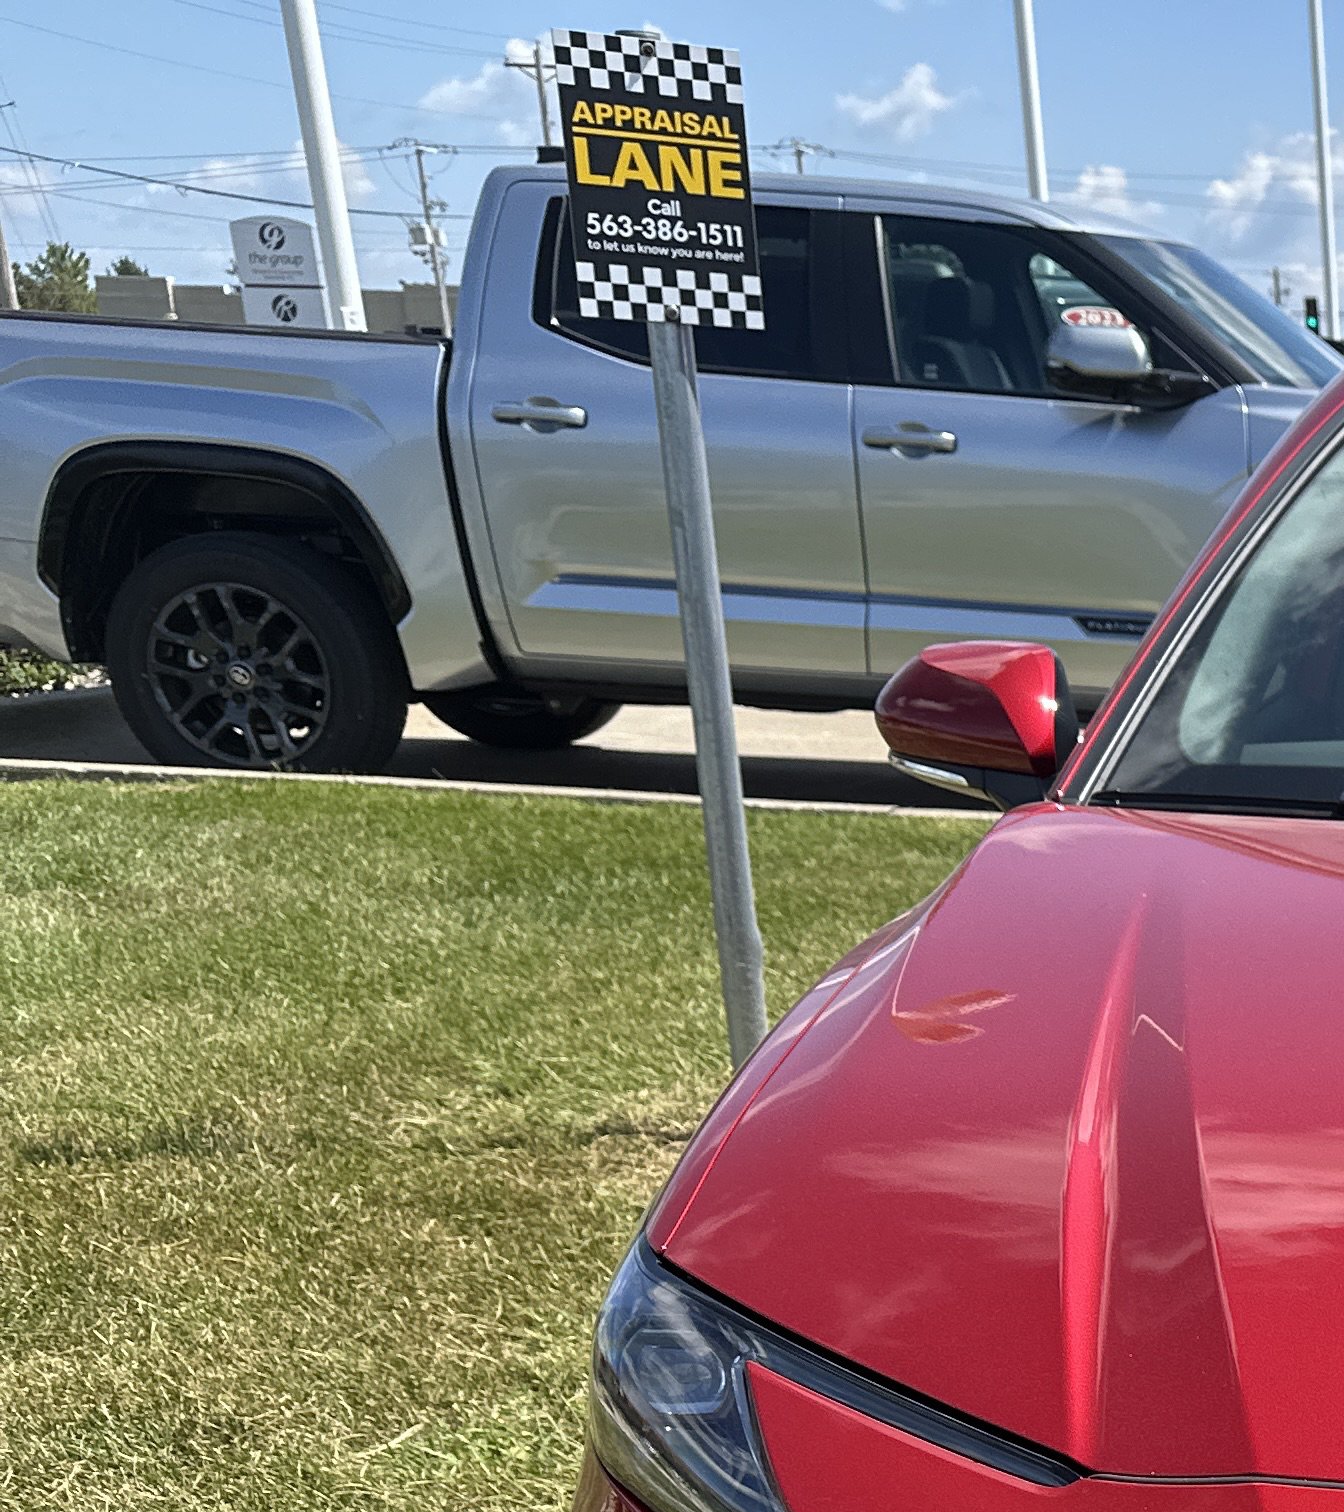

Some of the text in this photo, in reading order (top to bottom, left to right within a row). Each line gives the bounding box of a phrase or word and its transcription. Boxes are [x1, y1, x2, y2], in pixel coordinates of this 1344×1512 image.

[572, 100, 740, 140] APPRAISAL
[572, 136, 746, 199] LANE
[647, 198, 682, 217] Call
[586, 212, 745, 248] 563-386-1511
[587, 239, 745, 263] to let us know you are here!
